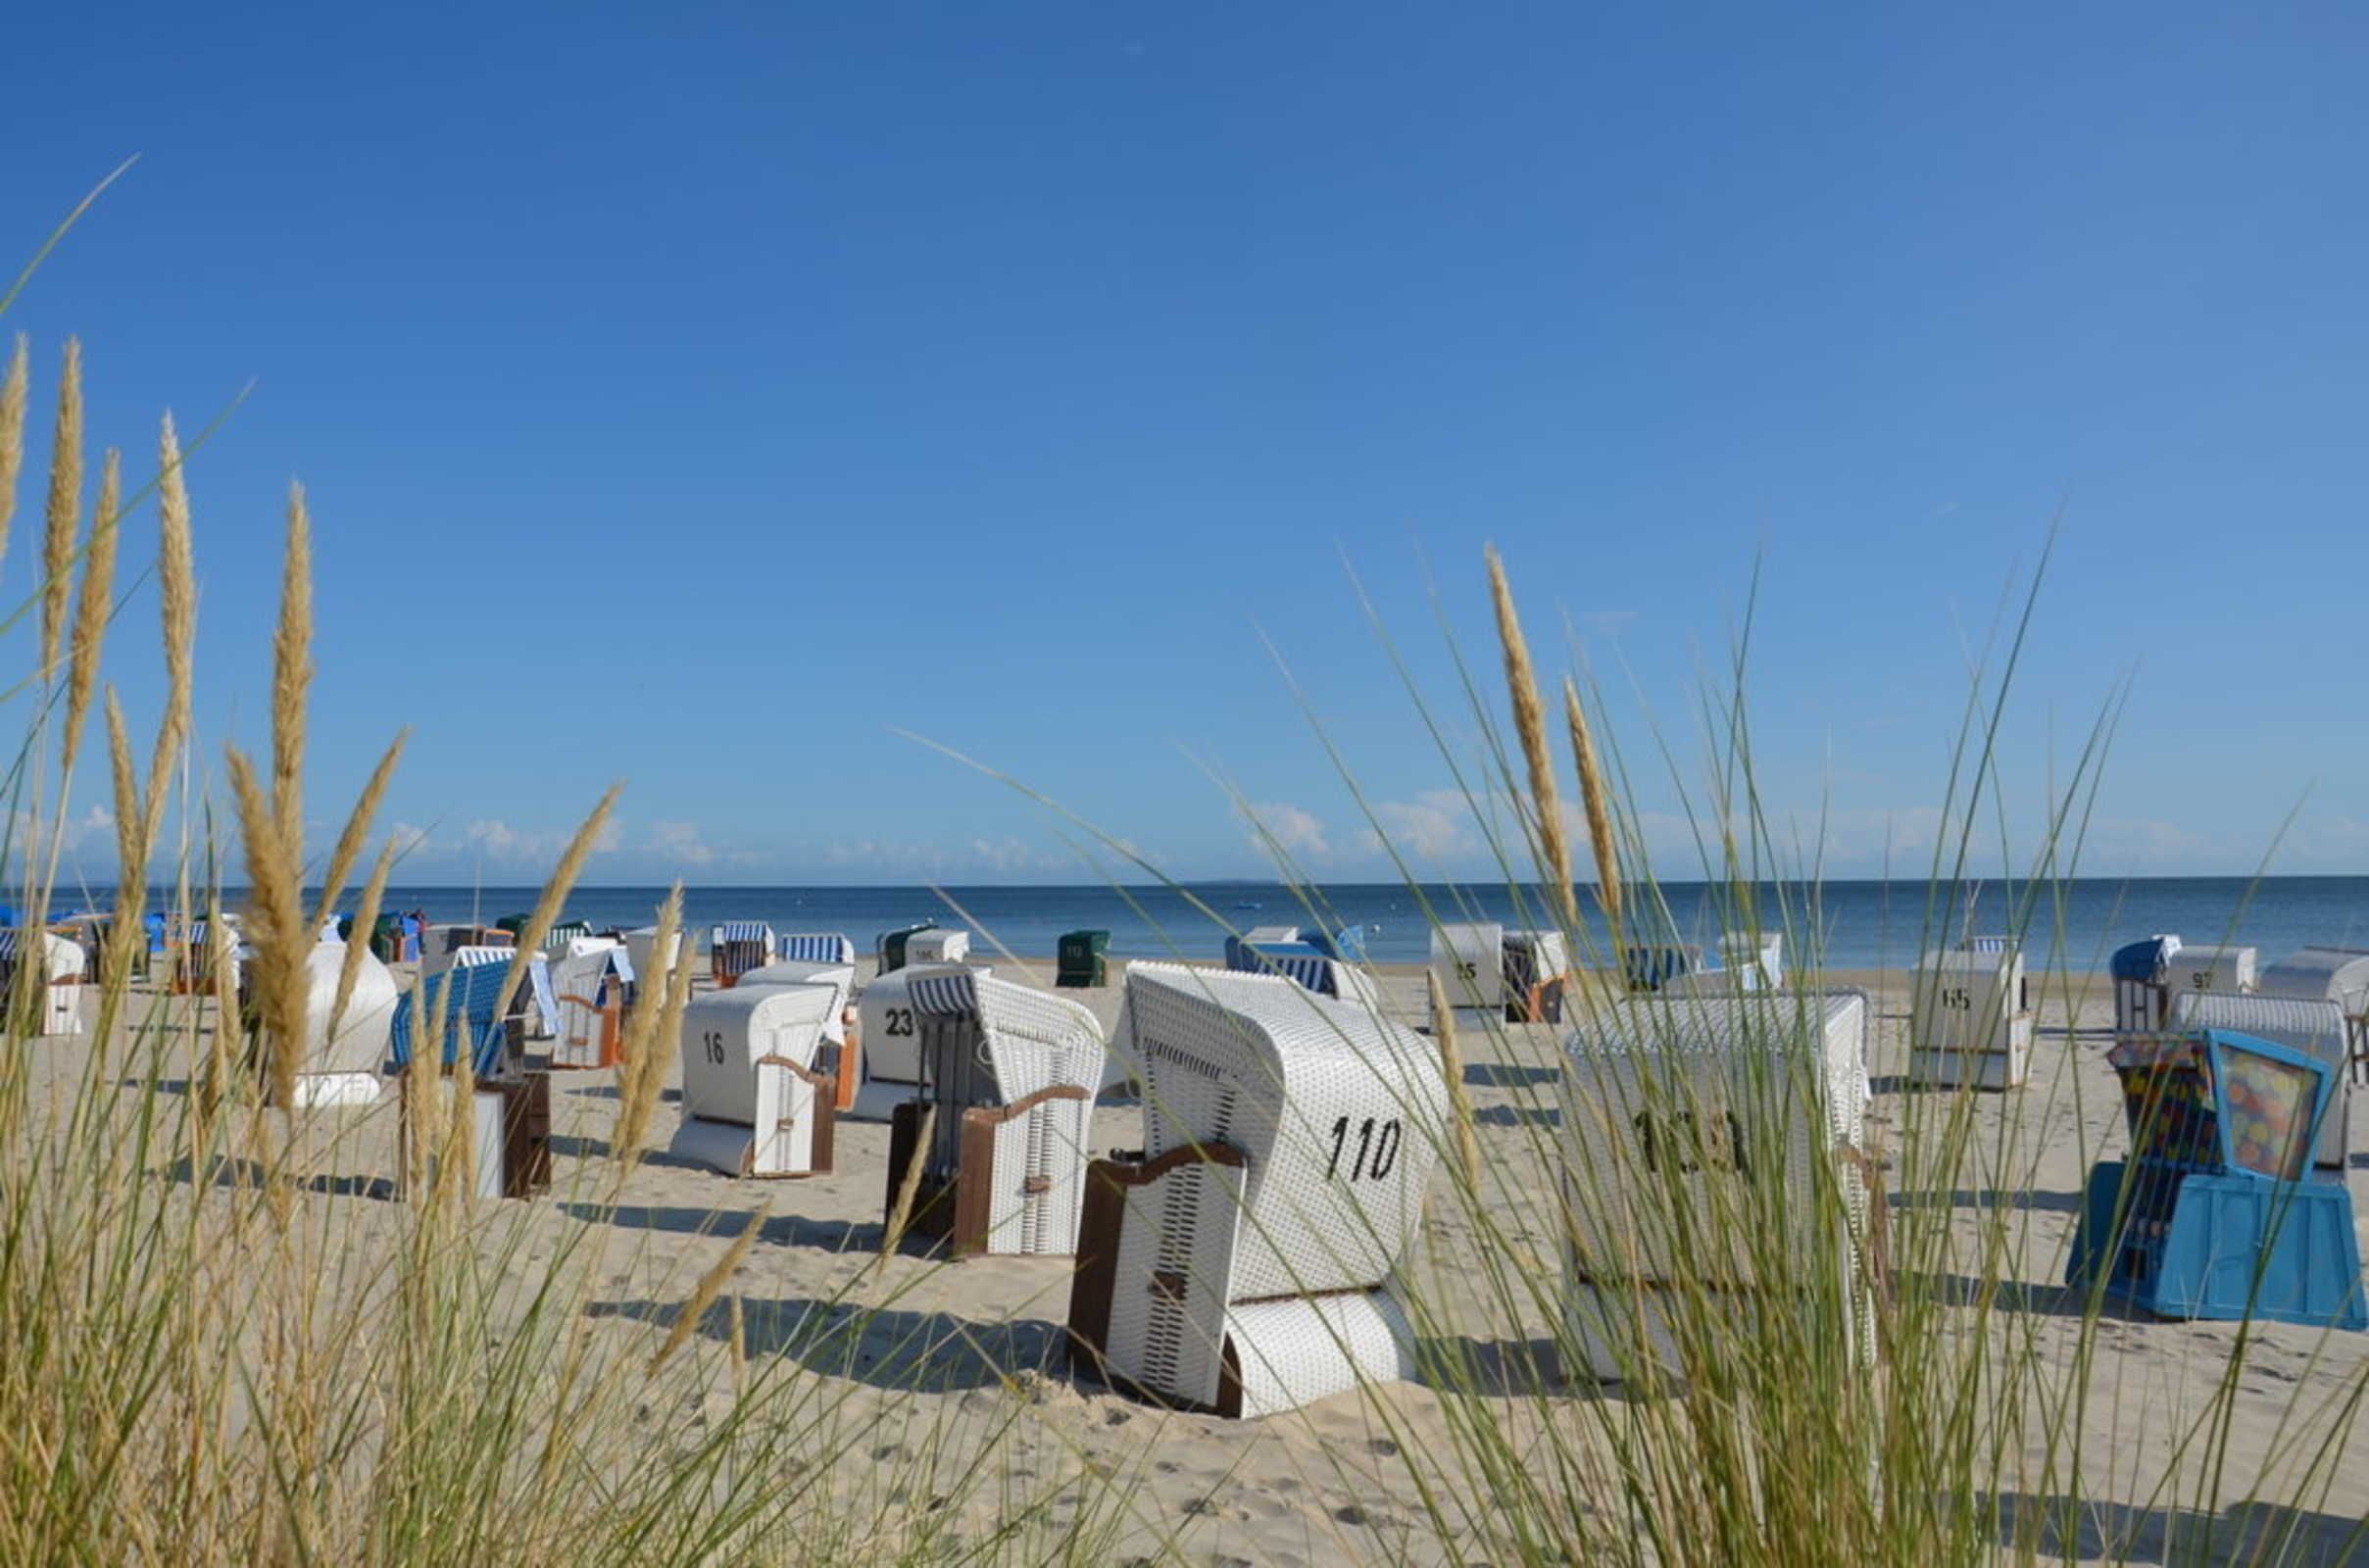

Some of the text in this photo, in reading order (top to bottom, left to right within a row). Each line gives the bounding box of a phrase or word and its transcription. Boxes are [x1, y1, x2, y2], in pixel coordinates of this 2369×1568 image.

[885, 1007, 913, 1037] 23
[704, 1031, 725, 1065] 16
[1326, 1116, 1402, 1182] 110
